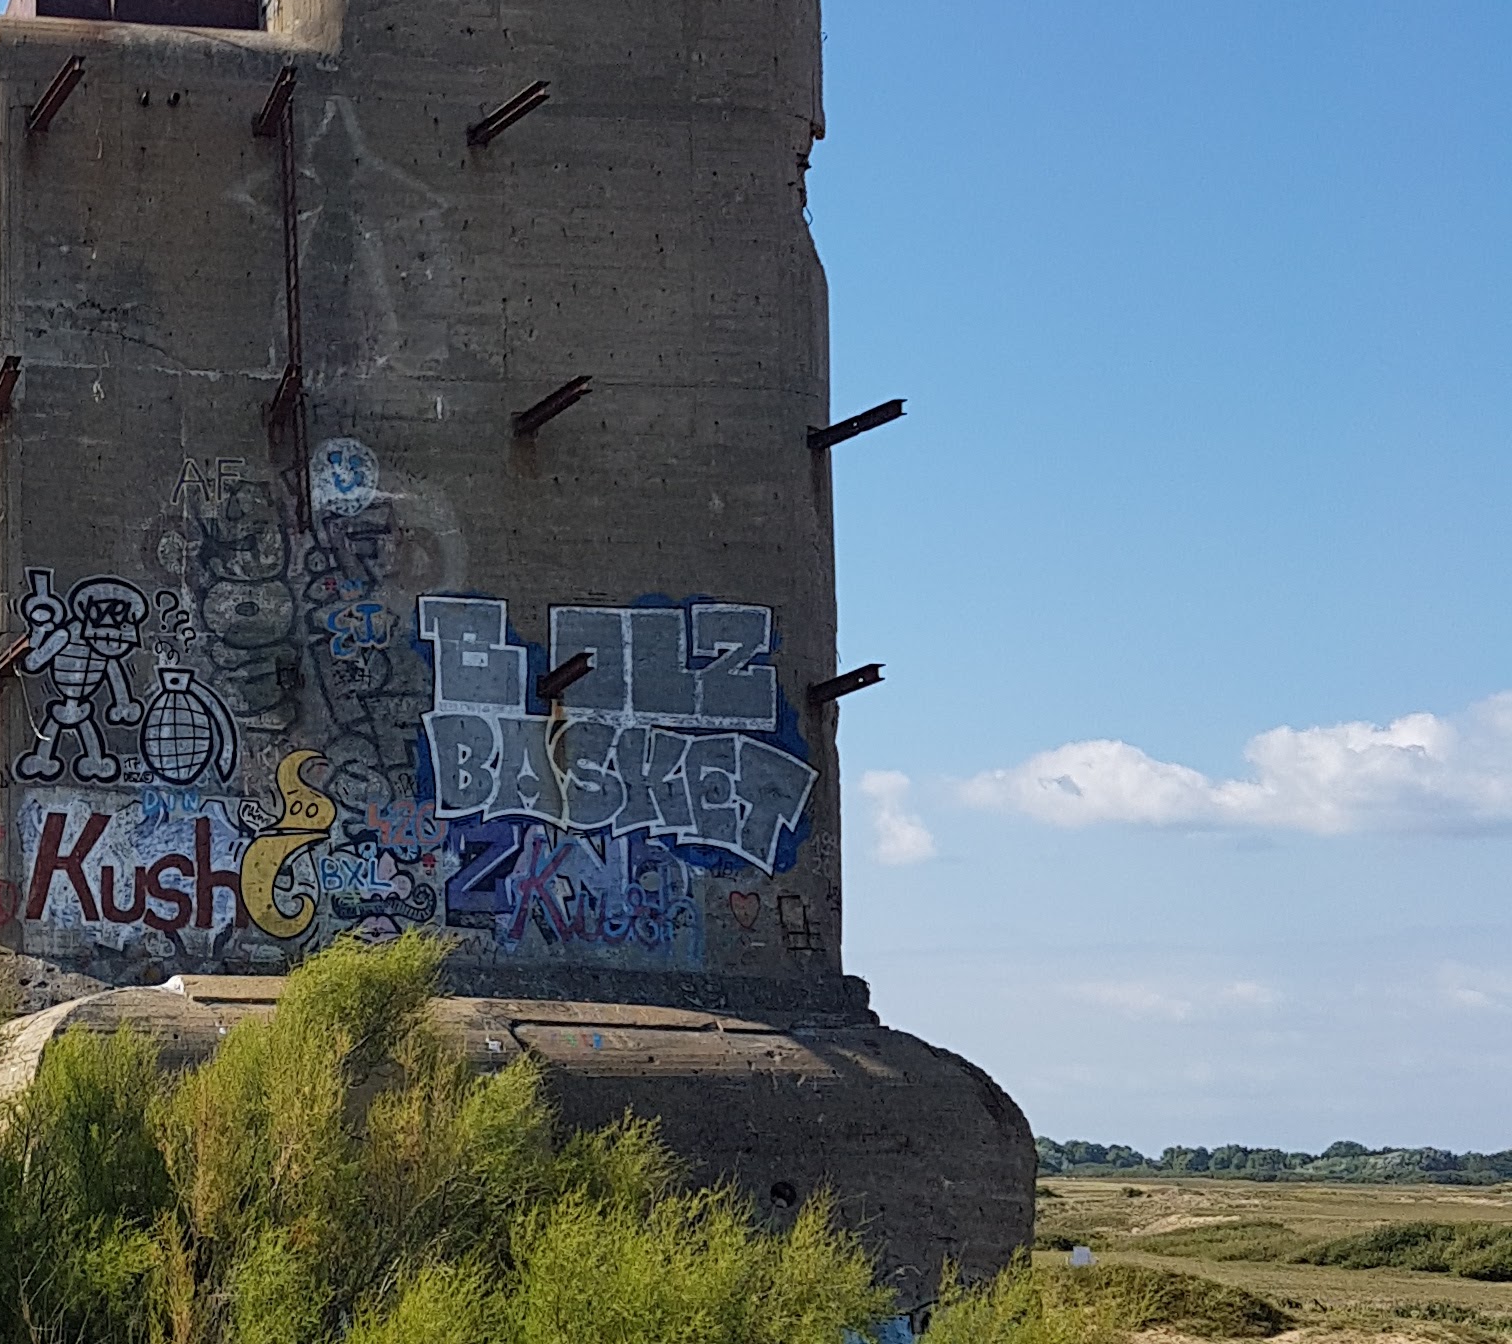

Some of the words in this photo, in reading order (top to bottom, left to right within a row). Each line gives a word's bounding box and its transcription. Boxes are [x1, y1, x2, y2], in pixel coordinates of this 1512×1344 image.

[367, 799, 448, 847] 420
[421, 712, 820, 878] BASKET
[24, 811, 249, 933] Kush
[319, 856, 394, 893] BXL
